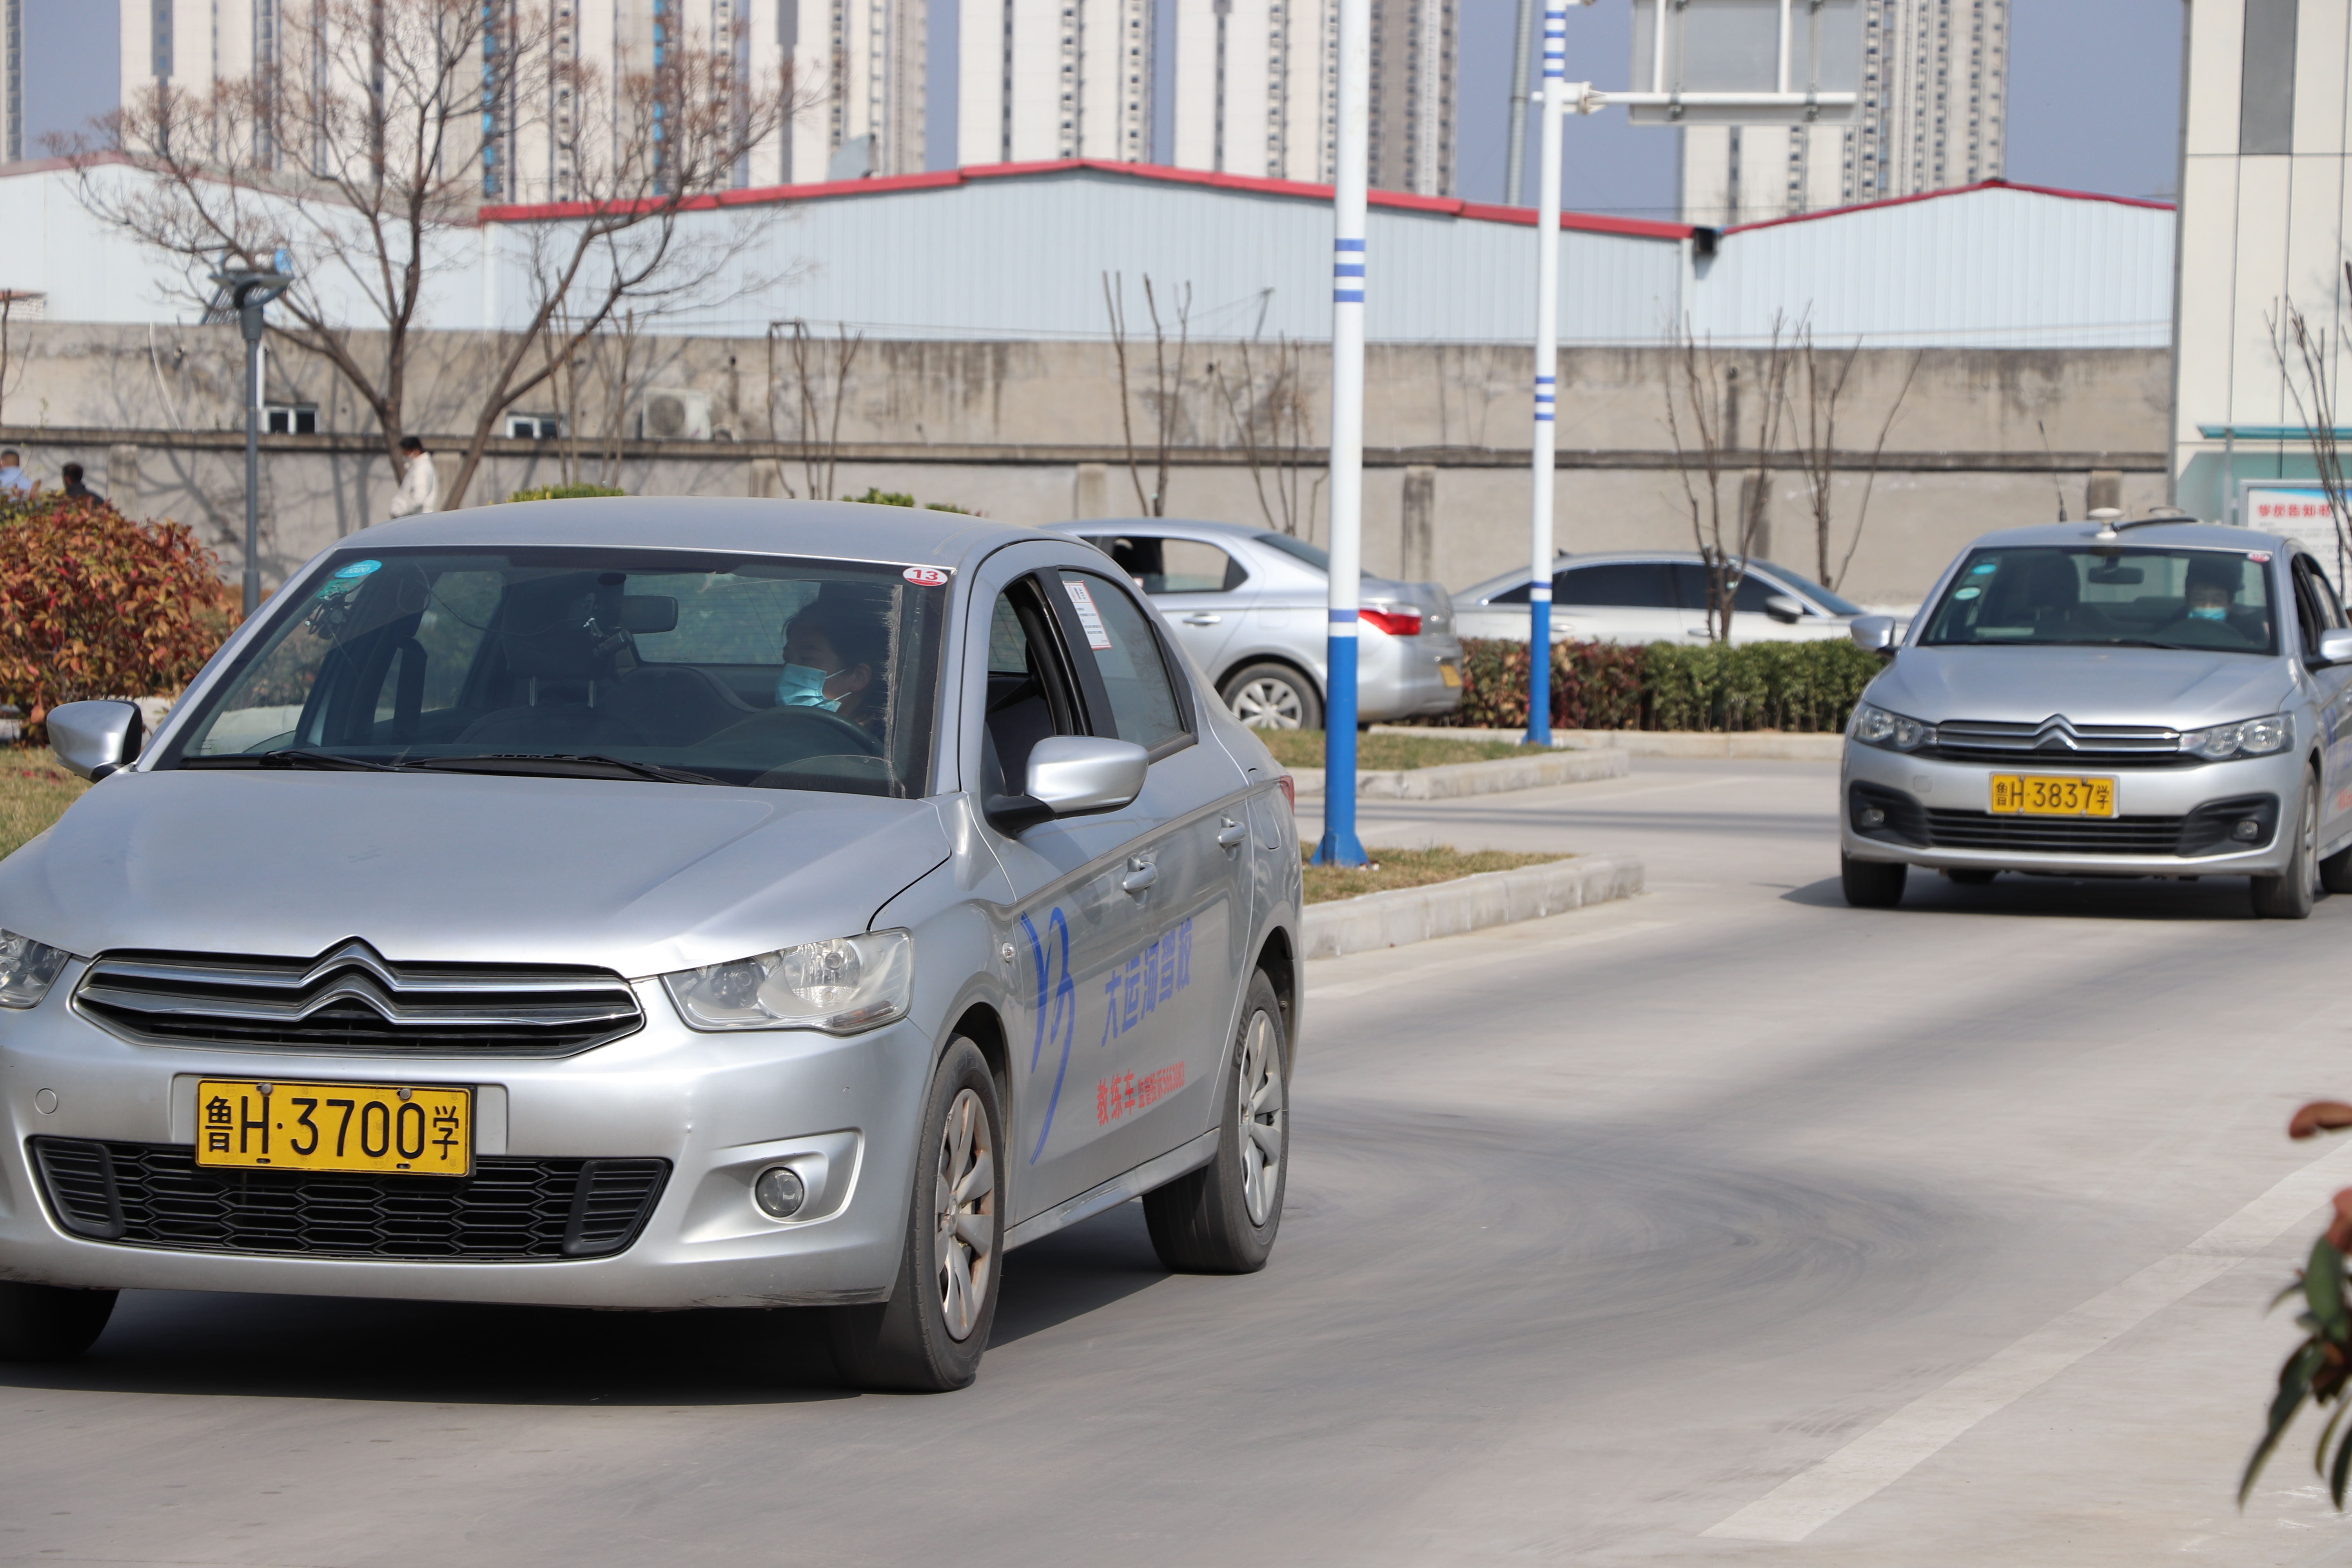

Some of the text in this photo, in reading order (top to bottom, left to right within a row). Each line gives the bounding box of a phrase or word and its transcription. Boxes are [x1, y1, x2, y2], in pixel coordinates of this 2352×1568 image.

[913, 569, 939, 580] 13
[1102, 916, 1193, 1047] 大运河驾校
[1097, 1068, 1136, 1127] 教练车
